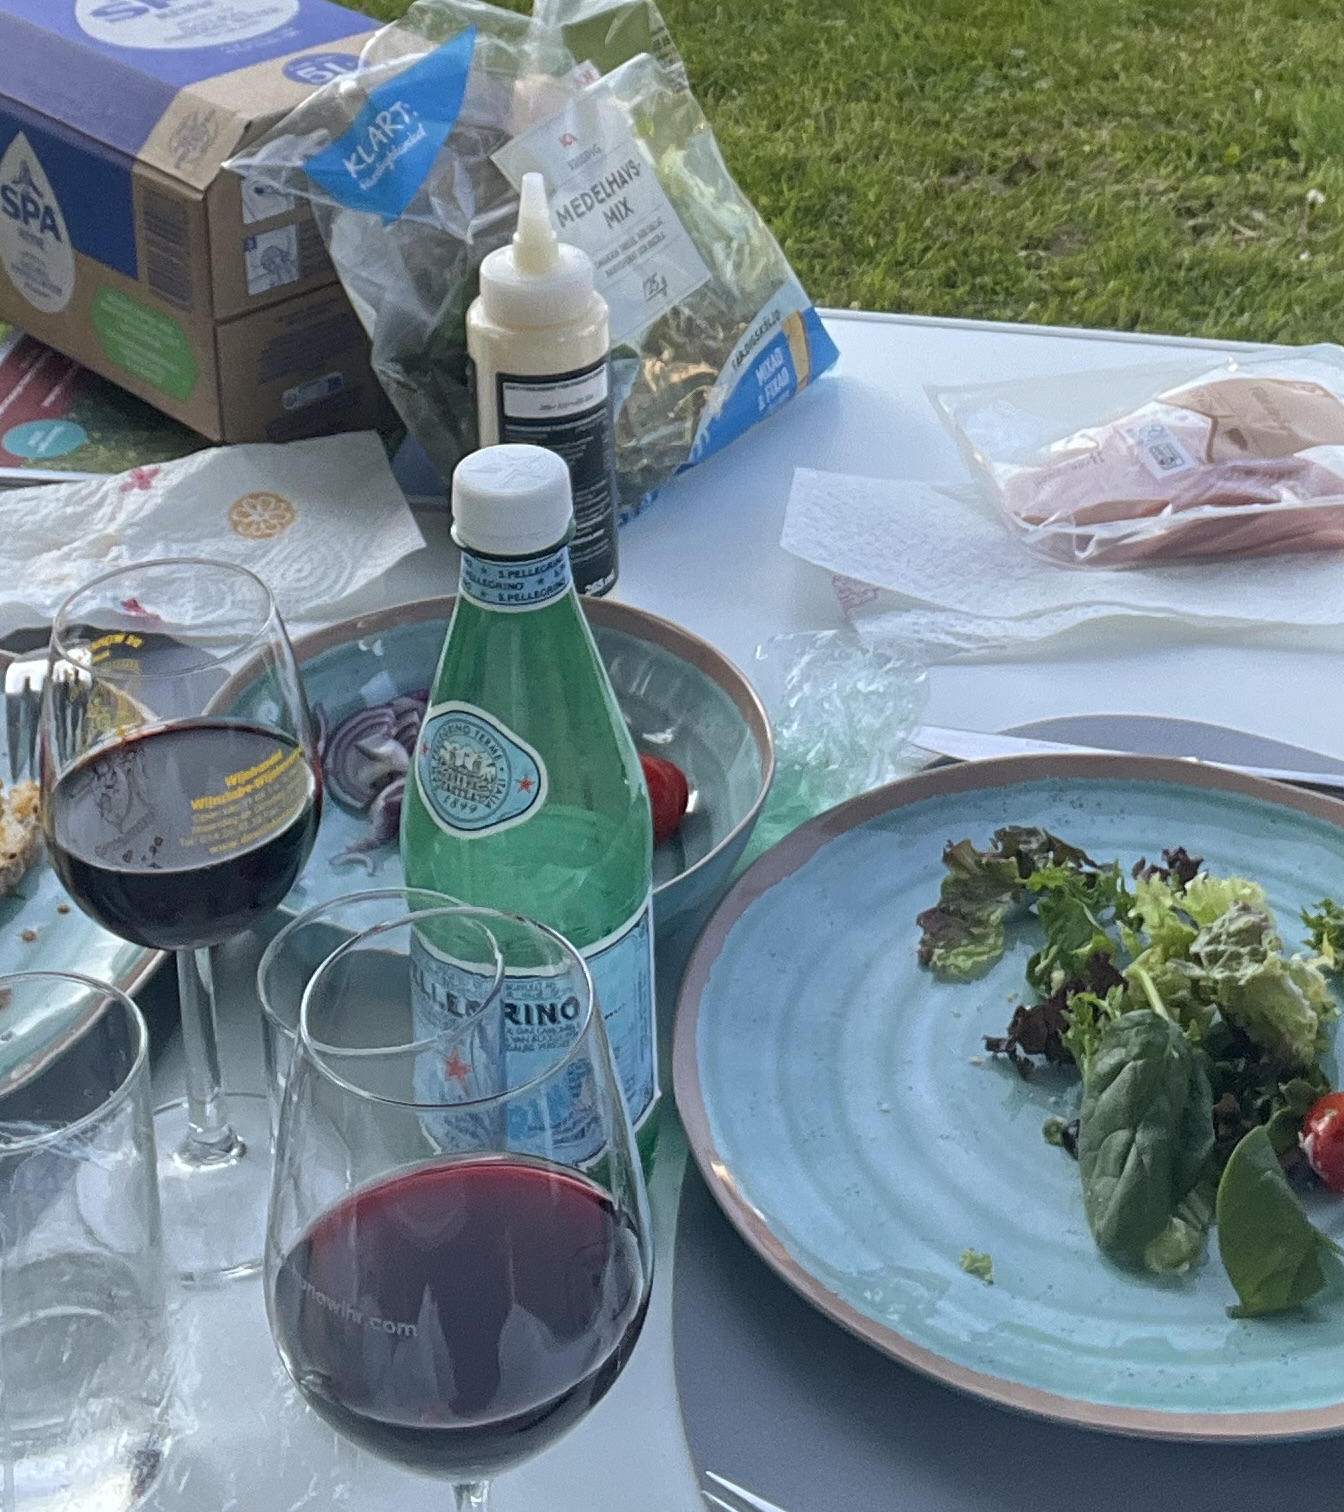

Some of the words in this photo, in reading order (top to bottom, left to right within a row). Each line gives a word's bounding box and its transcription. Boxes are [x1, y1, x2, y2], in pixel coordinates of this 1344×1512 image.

[0, 184, 62, 243] SPA
[556, 157, 641, 229] MEDELHAVS-
[602, 196, 635, 230] MIX
